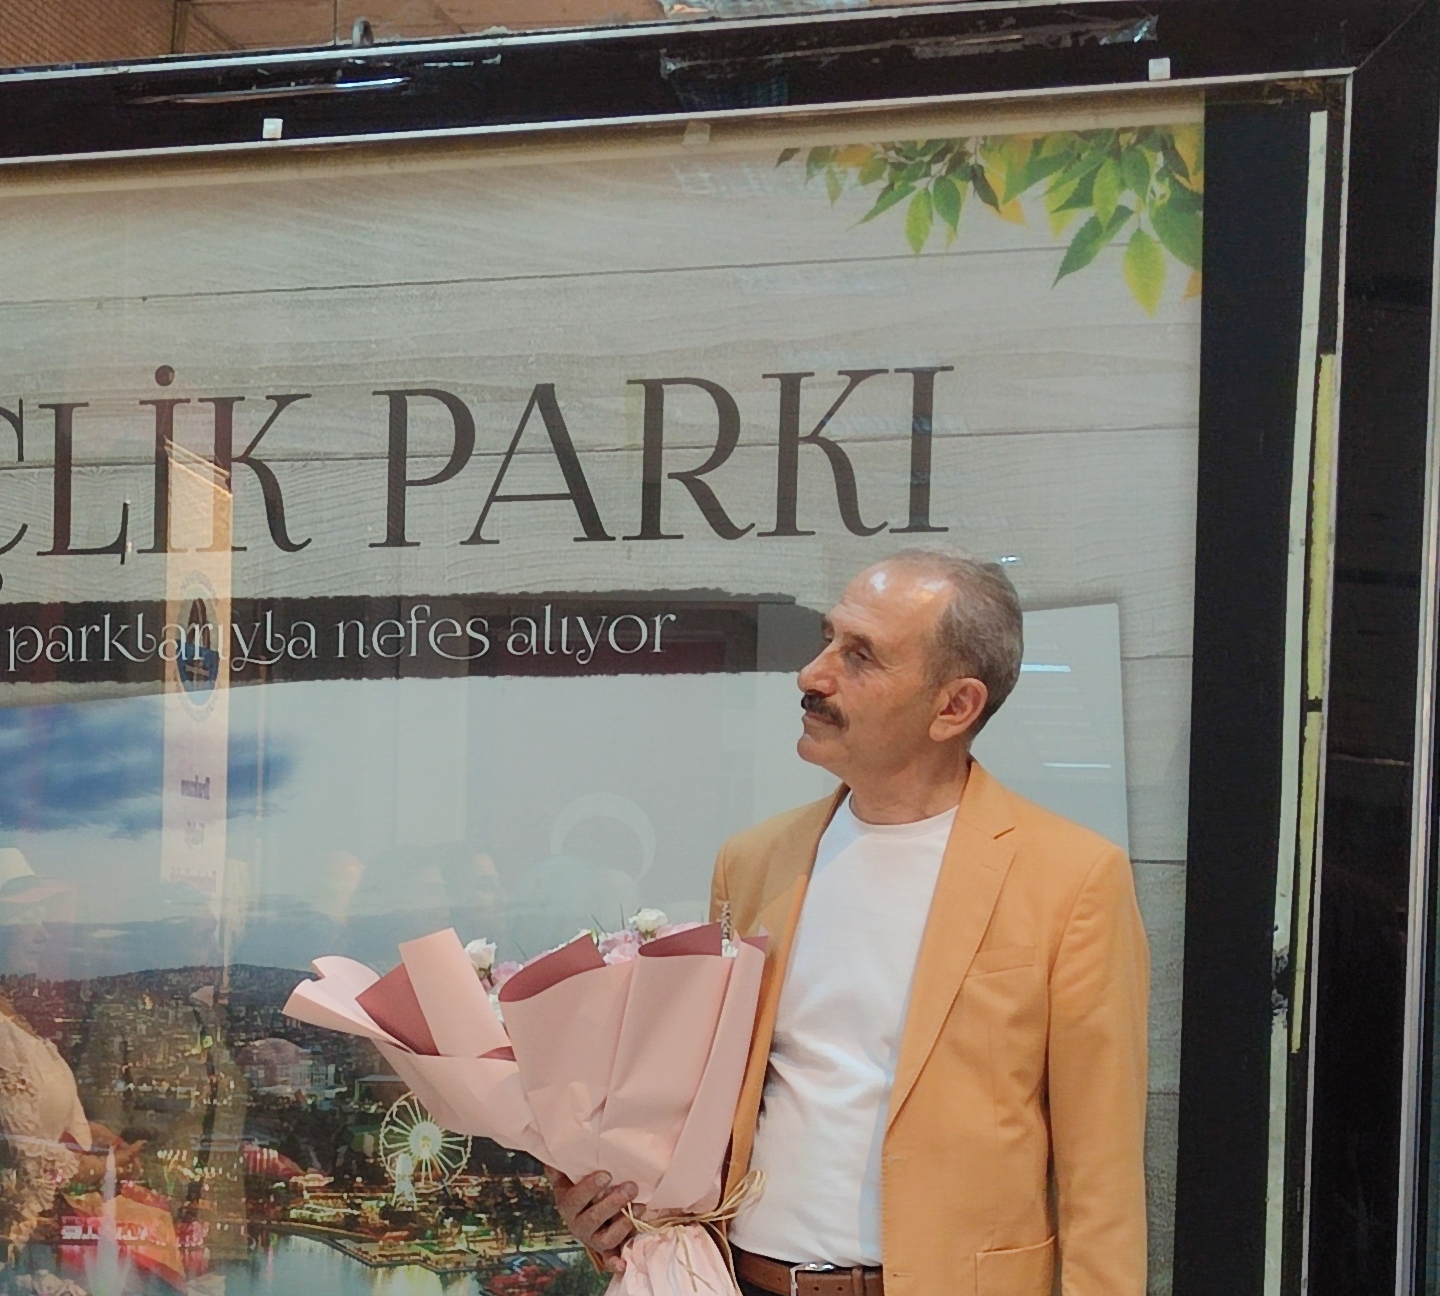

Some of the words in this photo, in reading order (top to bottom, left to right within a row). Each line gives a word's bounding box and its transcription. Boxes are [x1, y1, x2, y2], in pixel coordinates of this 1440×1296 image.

[369, 364, 954, 549] PARKI
[7, 610, 318, 672] parklarıyla
[334, 603, 491, 662] nefes
[505, 603, 677, 665] alıyor
